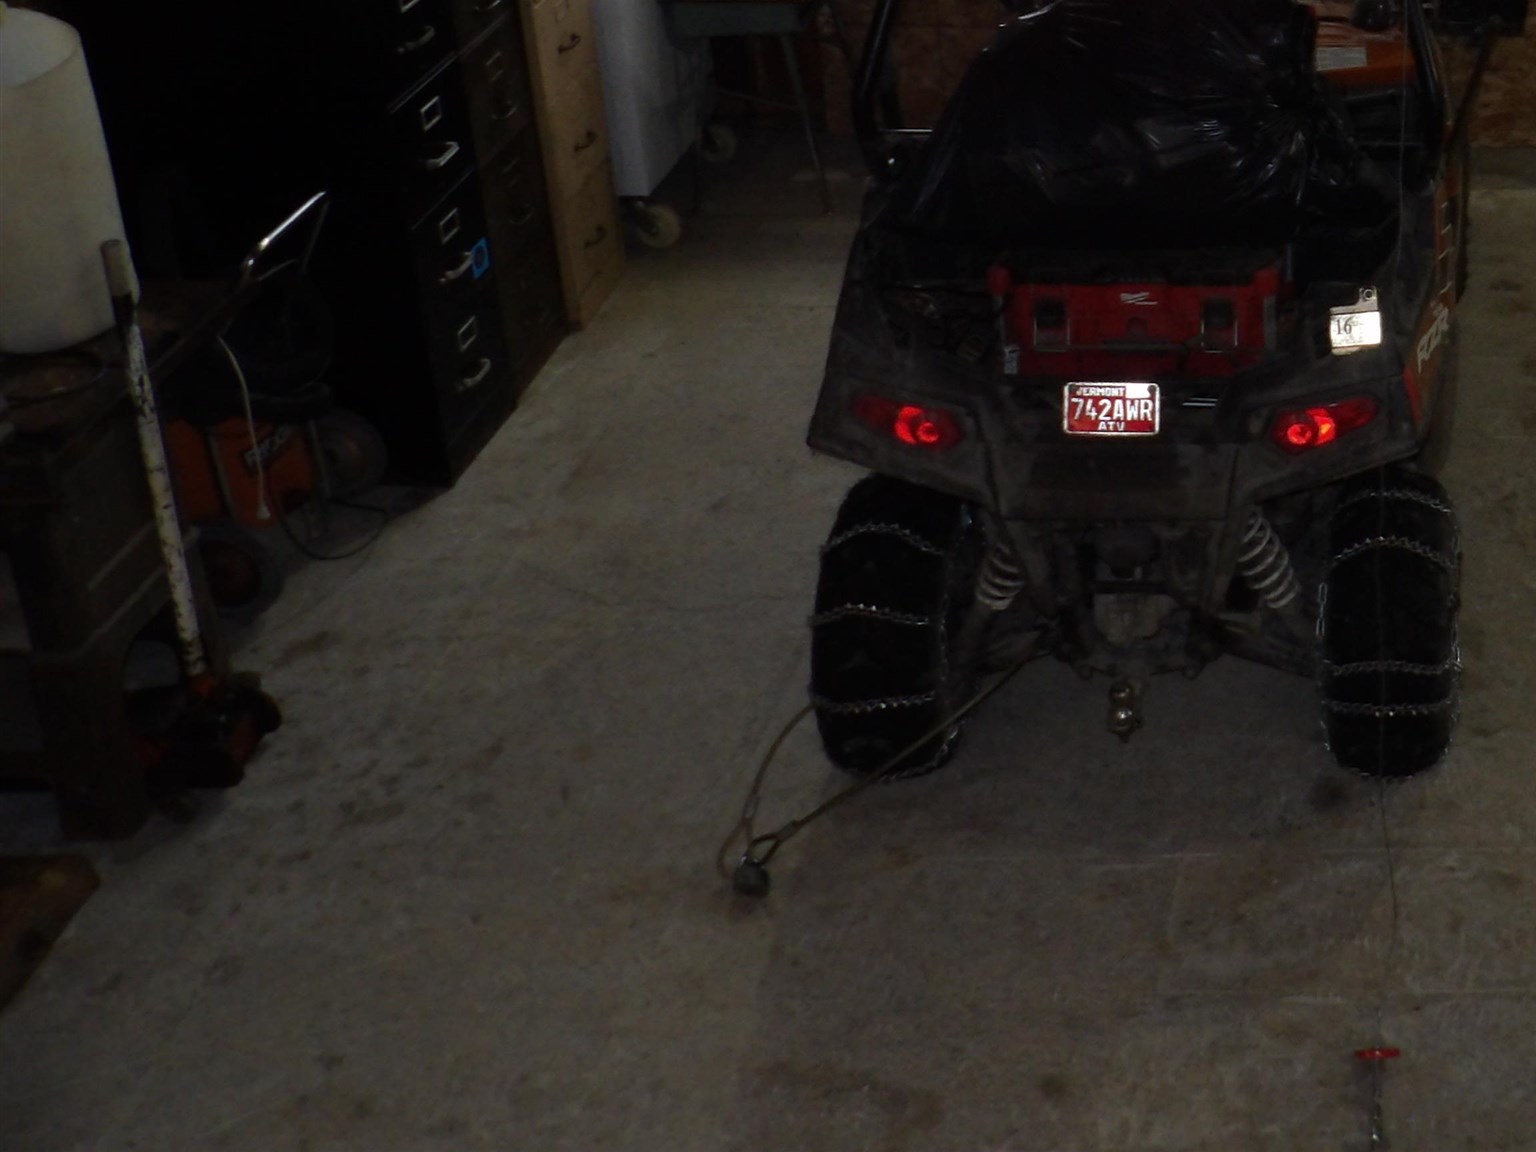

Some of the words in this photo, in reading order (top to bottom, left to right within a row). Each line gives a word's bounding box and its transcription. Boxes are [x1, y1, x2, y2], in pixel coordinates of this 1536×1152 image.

[1336, 318, 1353, 335] 16
[1071, 398, 1153, 421] 742AWR
[1097, 421, 1126, 431] ATV
